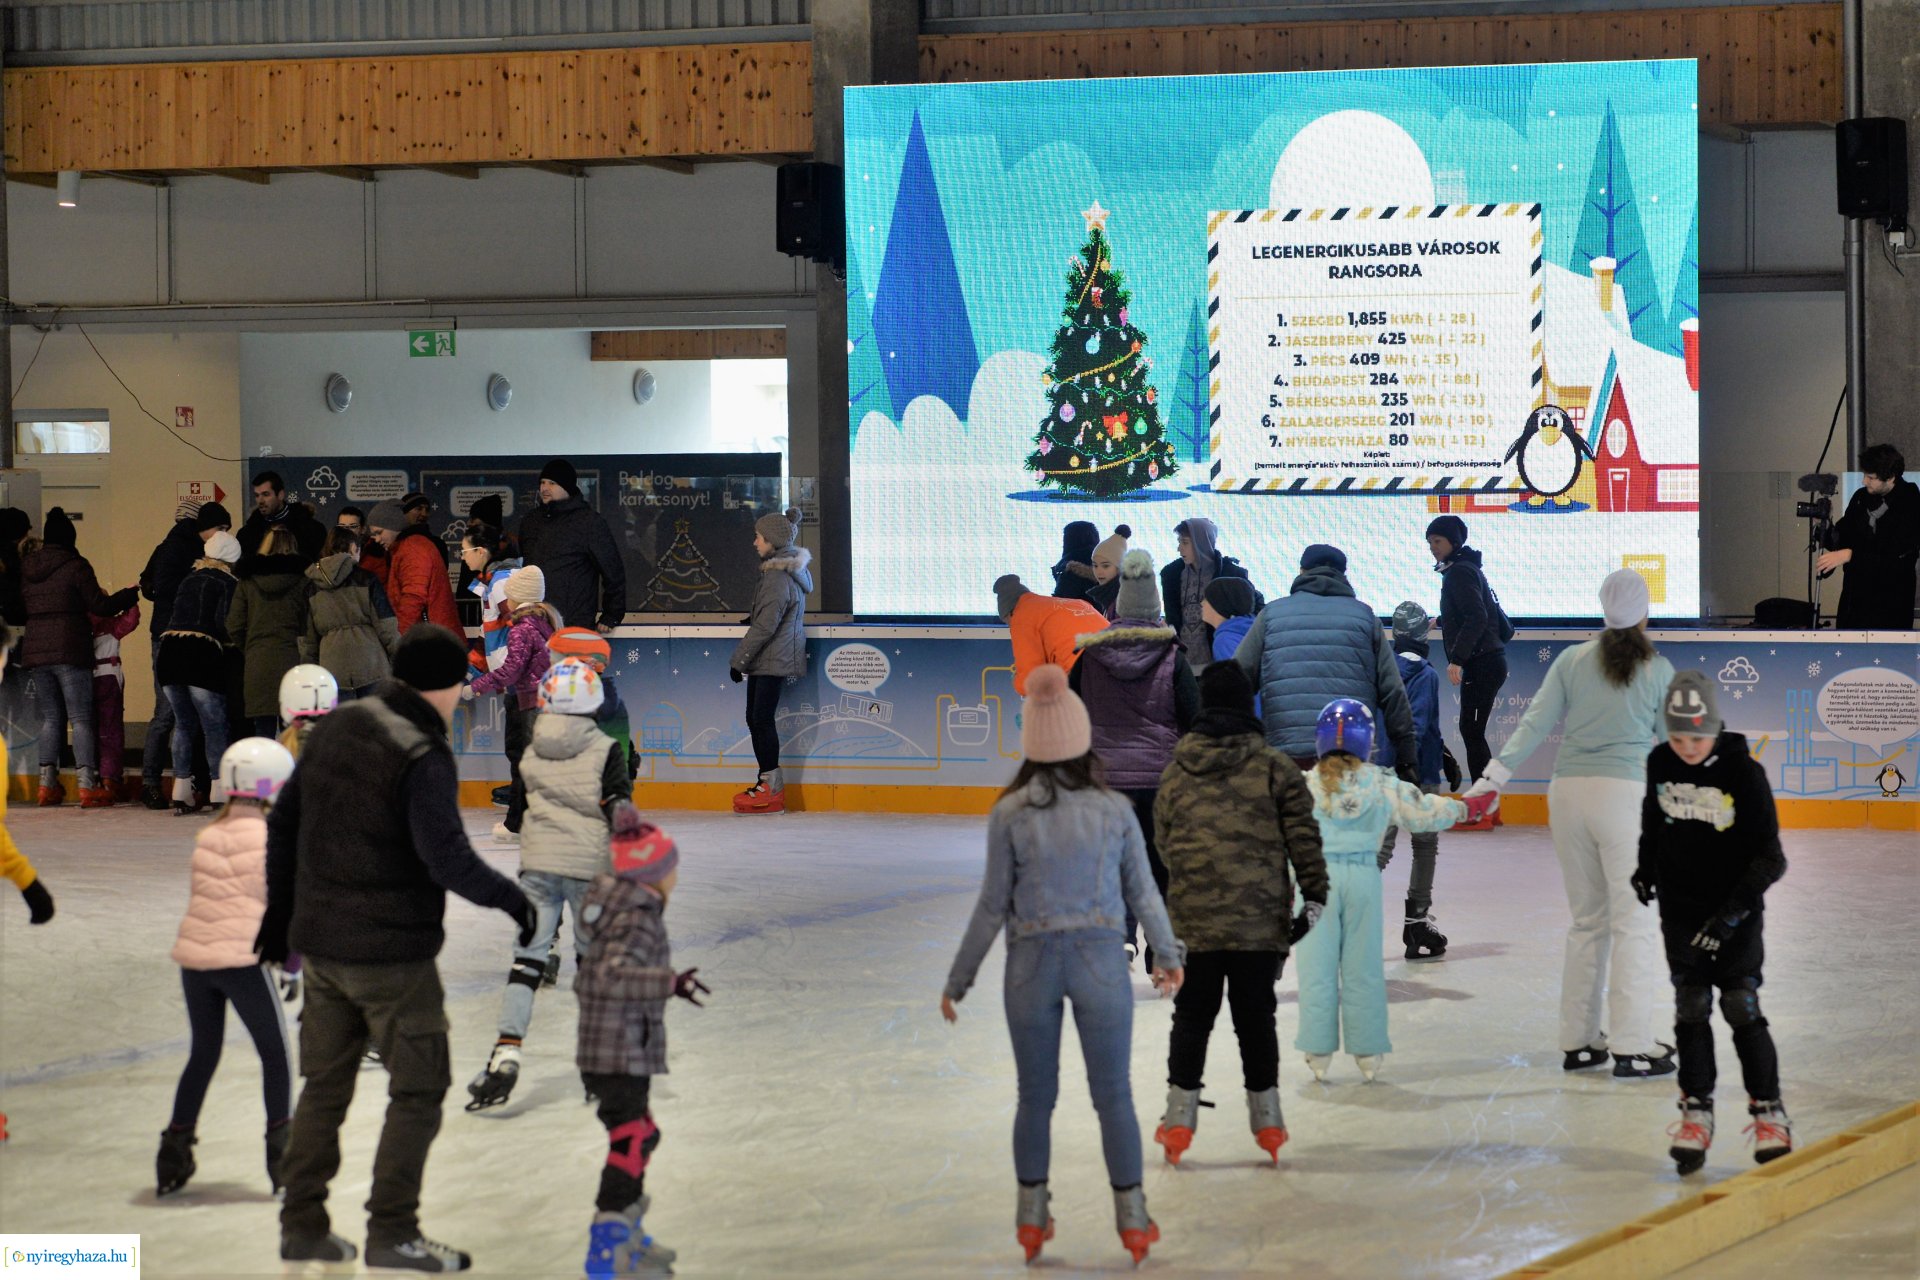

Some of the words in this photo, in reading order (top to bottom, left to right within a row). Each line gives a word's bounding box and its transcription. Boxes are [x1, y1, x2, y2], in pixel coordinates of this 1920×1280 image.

[1252, 243, 1412, 259] LEGENERGIKUSABB
[1416, 239, 1500, 256] VÁROSOK
[1329, 263, 1422, 279] RANGSORA
[1277, 313, 1287, 327] 1.
[1291, 315, 1345, 327] SZEGED
[1347, 311, 1387, 328] 1,855
[1268, 334, 1280, 347] 2.
[1377, 332, 1407, 345] 425
[1293, 353, 1307, 366] 3.
[1350, 353, 1380, 365] 409
[1273, 374, 1288, 386] 4.
[1292, 374, 1366, 386] BUDAPEST
[1370, 372, 1399, 385] 284
[1269, 394, 1282, 407] 5.
[1381, 392, 1409, 406] 235
[1260, 414, 1275, 427] 6.
[1279, 415, 1387, 428] ZALAEGERSZEG
[1390, 412, 1415, 426] 201
[1269, 434, 1282, 447] 7.
[1389, 433, 1409, 446] 80
[619, 470, 674, 491] Boldog
[619, 490, 711, 510] karácsonyt!
